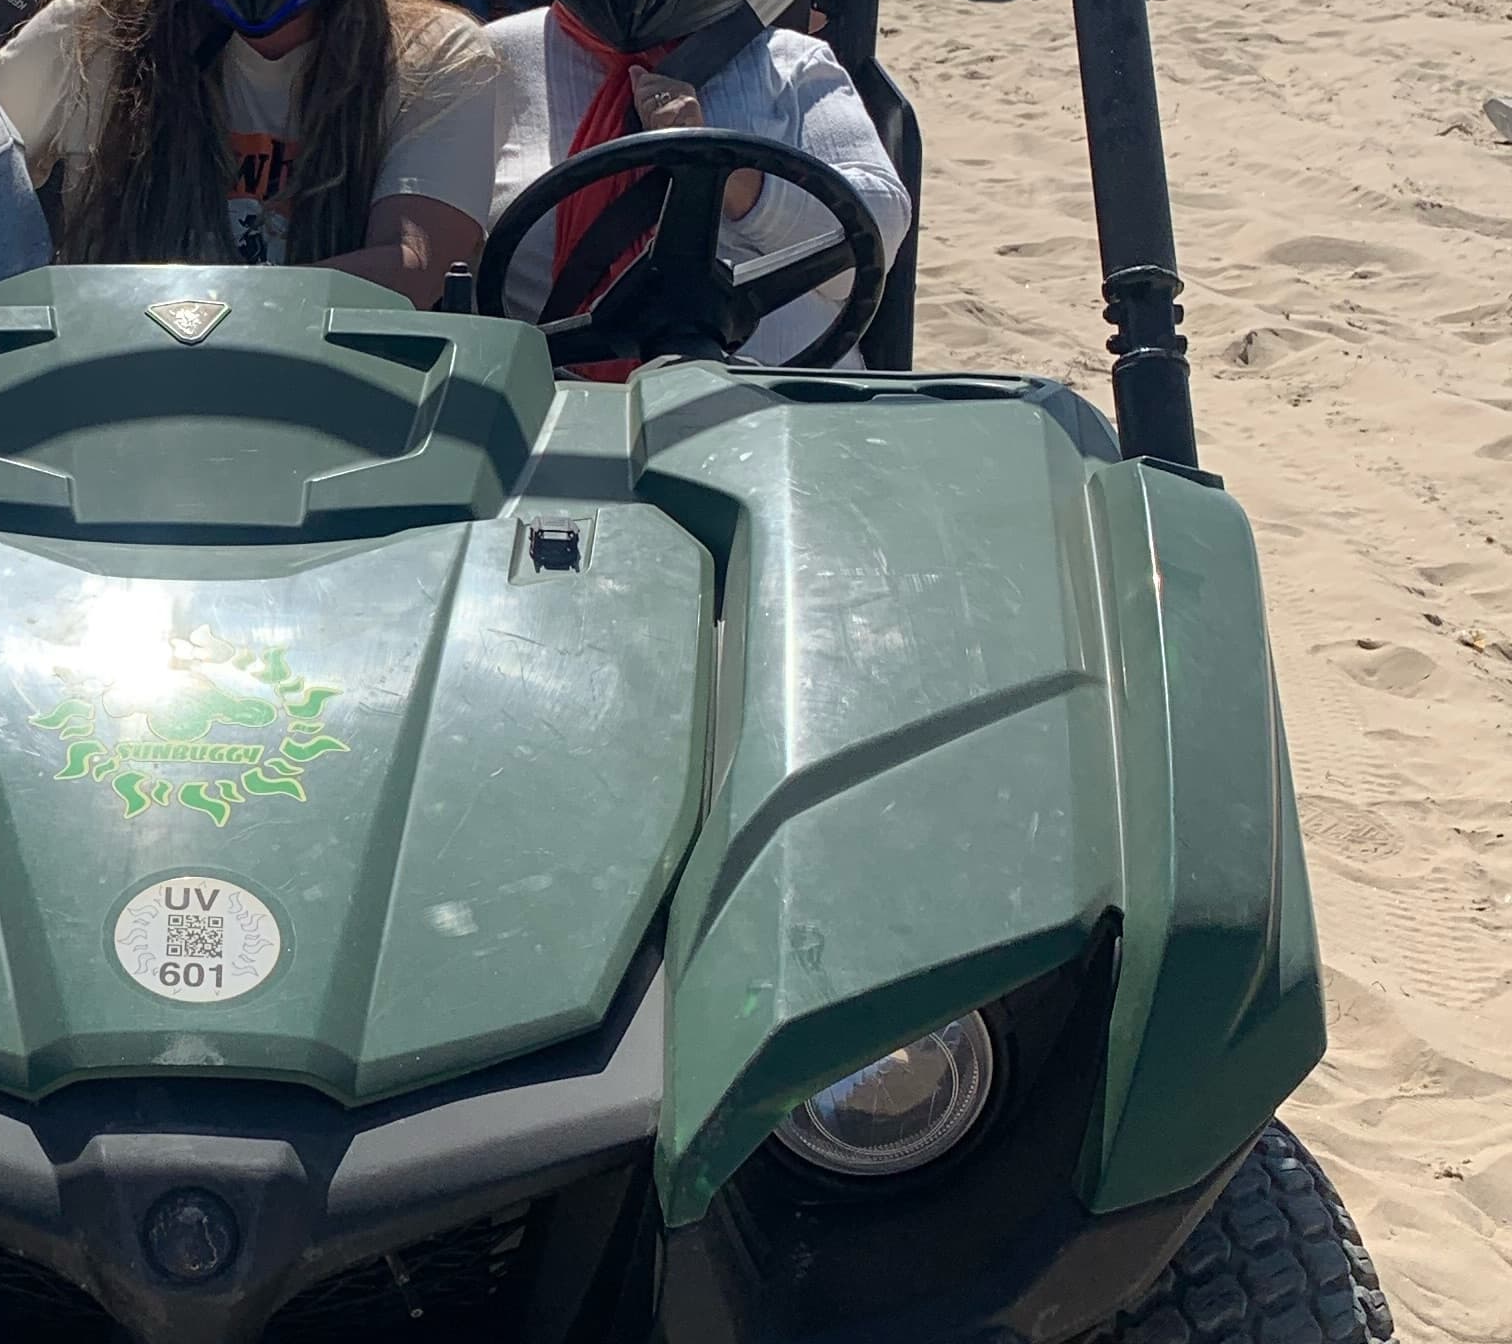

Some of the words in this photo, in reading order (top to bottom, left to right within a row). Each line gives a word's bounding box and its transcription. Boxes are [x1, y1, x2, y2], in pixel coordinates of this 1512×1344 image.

[116, 743, 264, 764] SUNBUGGY
[164, 887, 220, 911] UV
[159, 962, 223, 988] 601
